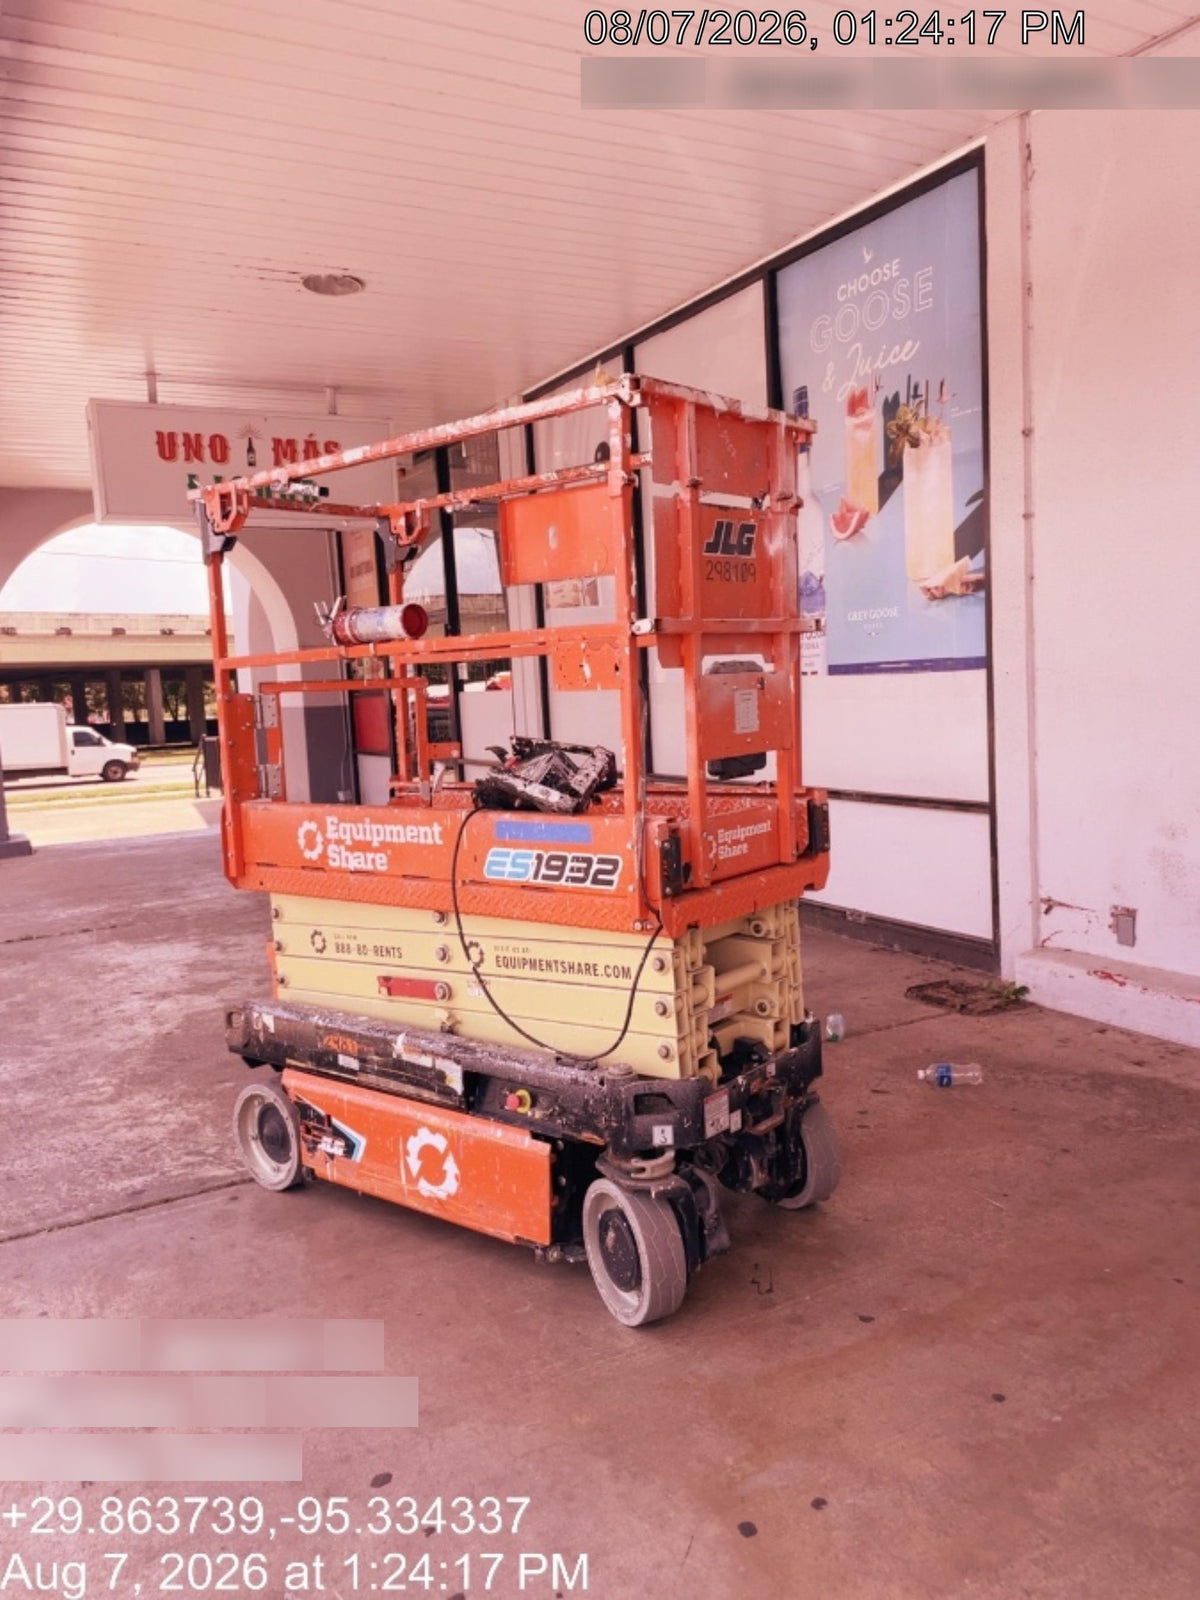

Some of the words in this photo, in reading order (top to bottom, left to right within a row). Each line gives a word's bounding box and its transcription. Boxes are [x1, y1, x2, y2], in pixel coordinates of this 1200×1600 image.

[837, 259, 900, 301] CHOOSE
[810, 266, 933, 353] GOOSE
[837, 340, 920, 401] Juice
[155, 430, 231, 464] UNO
[703, 520, 757, 557] JLG
[705, 560, 756, 583] 298109
[326, 815, 443, 847] Equipment
[717, 820, 771, 843] Equipment
[326, 844, 388, 871] Share
[717, 843, 748, 859] Share
[485, 849, 621, 889] ES1932
[334, 942, 403, 959] 888-80-RENTS
[495, 955, 633, 980] EQUIPMENTSHARE.COM
